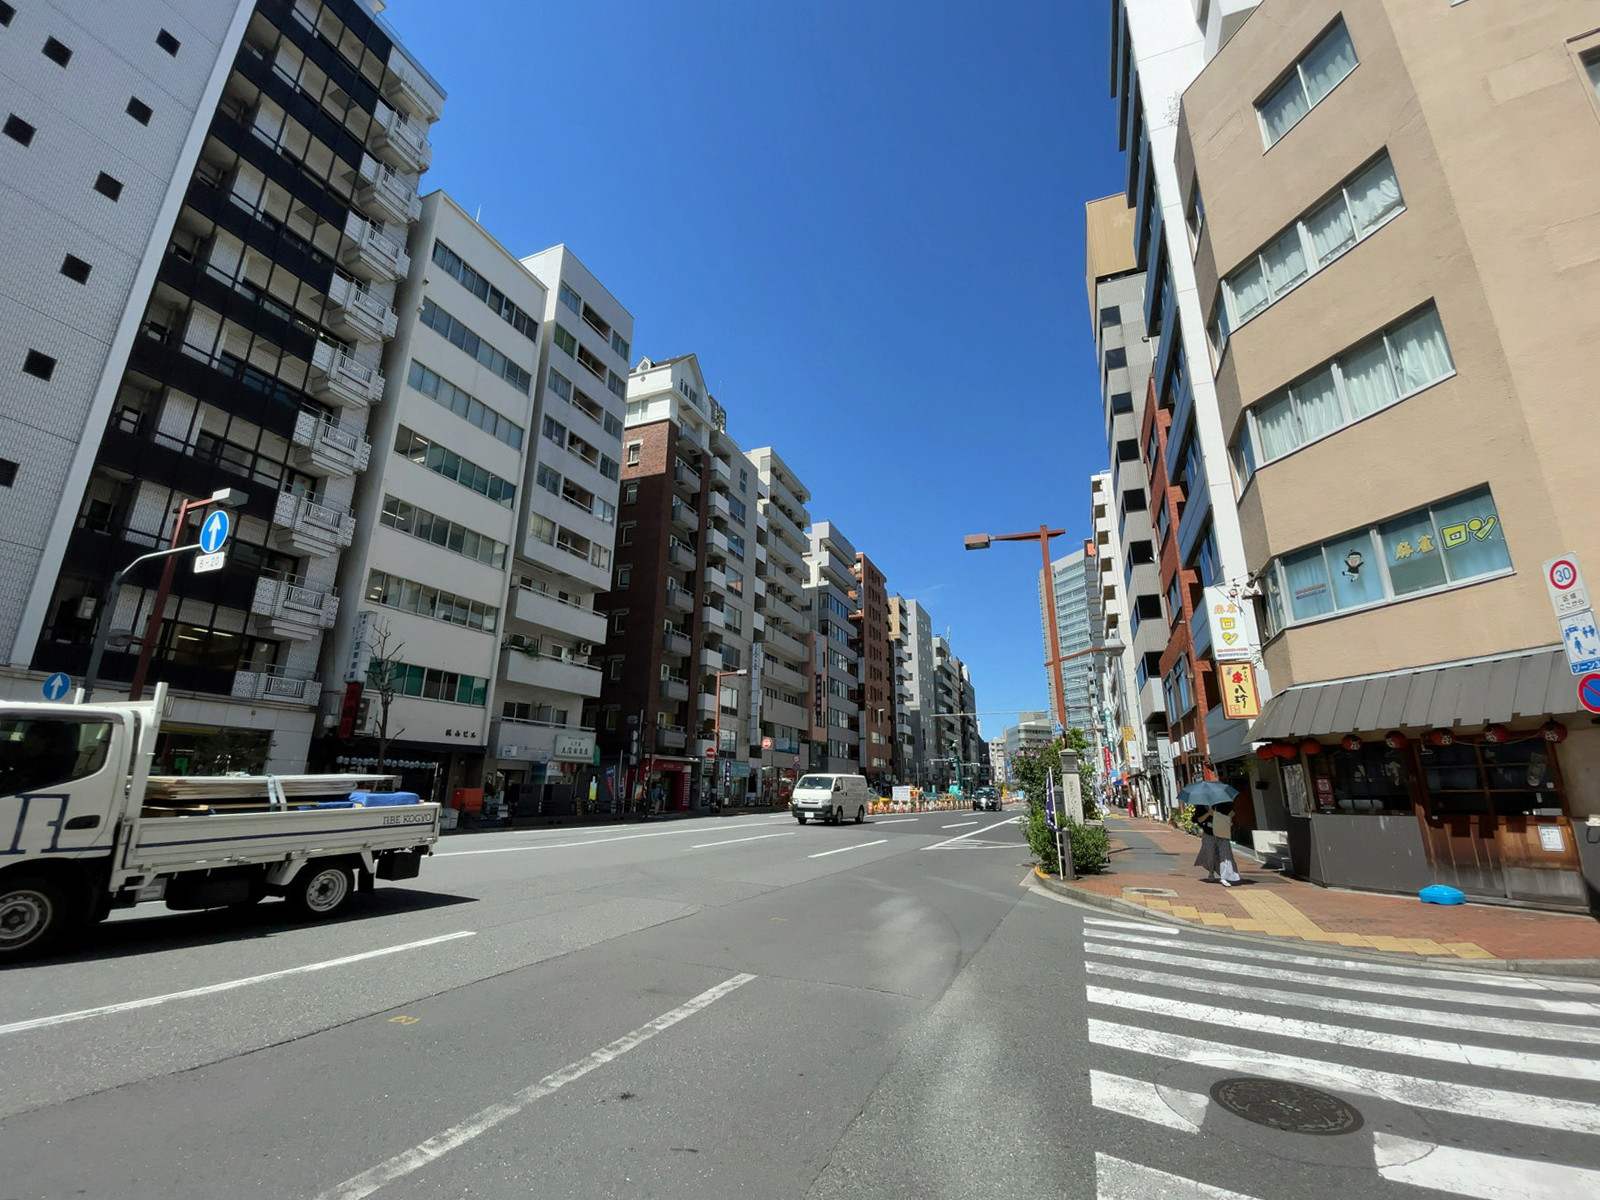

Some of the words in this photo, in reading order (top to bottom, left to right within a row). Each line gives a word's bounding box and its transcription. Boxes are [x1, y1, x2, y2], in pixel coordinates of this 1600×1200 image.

[1395, 534, 1436, 561] 麻雀
[1440, 515, 1498, 550] ロン
[1555, 567, 1571, 582] 30
[1559, 598, 1584, 611] ここから
[1562, 593, 1577, 602] 区域
[1220, 617, 1239, 646] ロン
[402, 813, 432, 823] KOGYO
